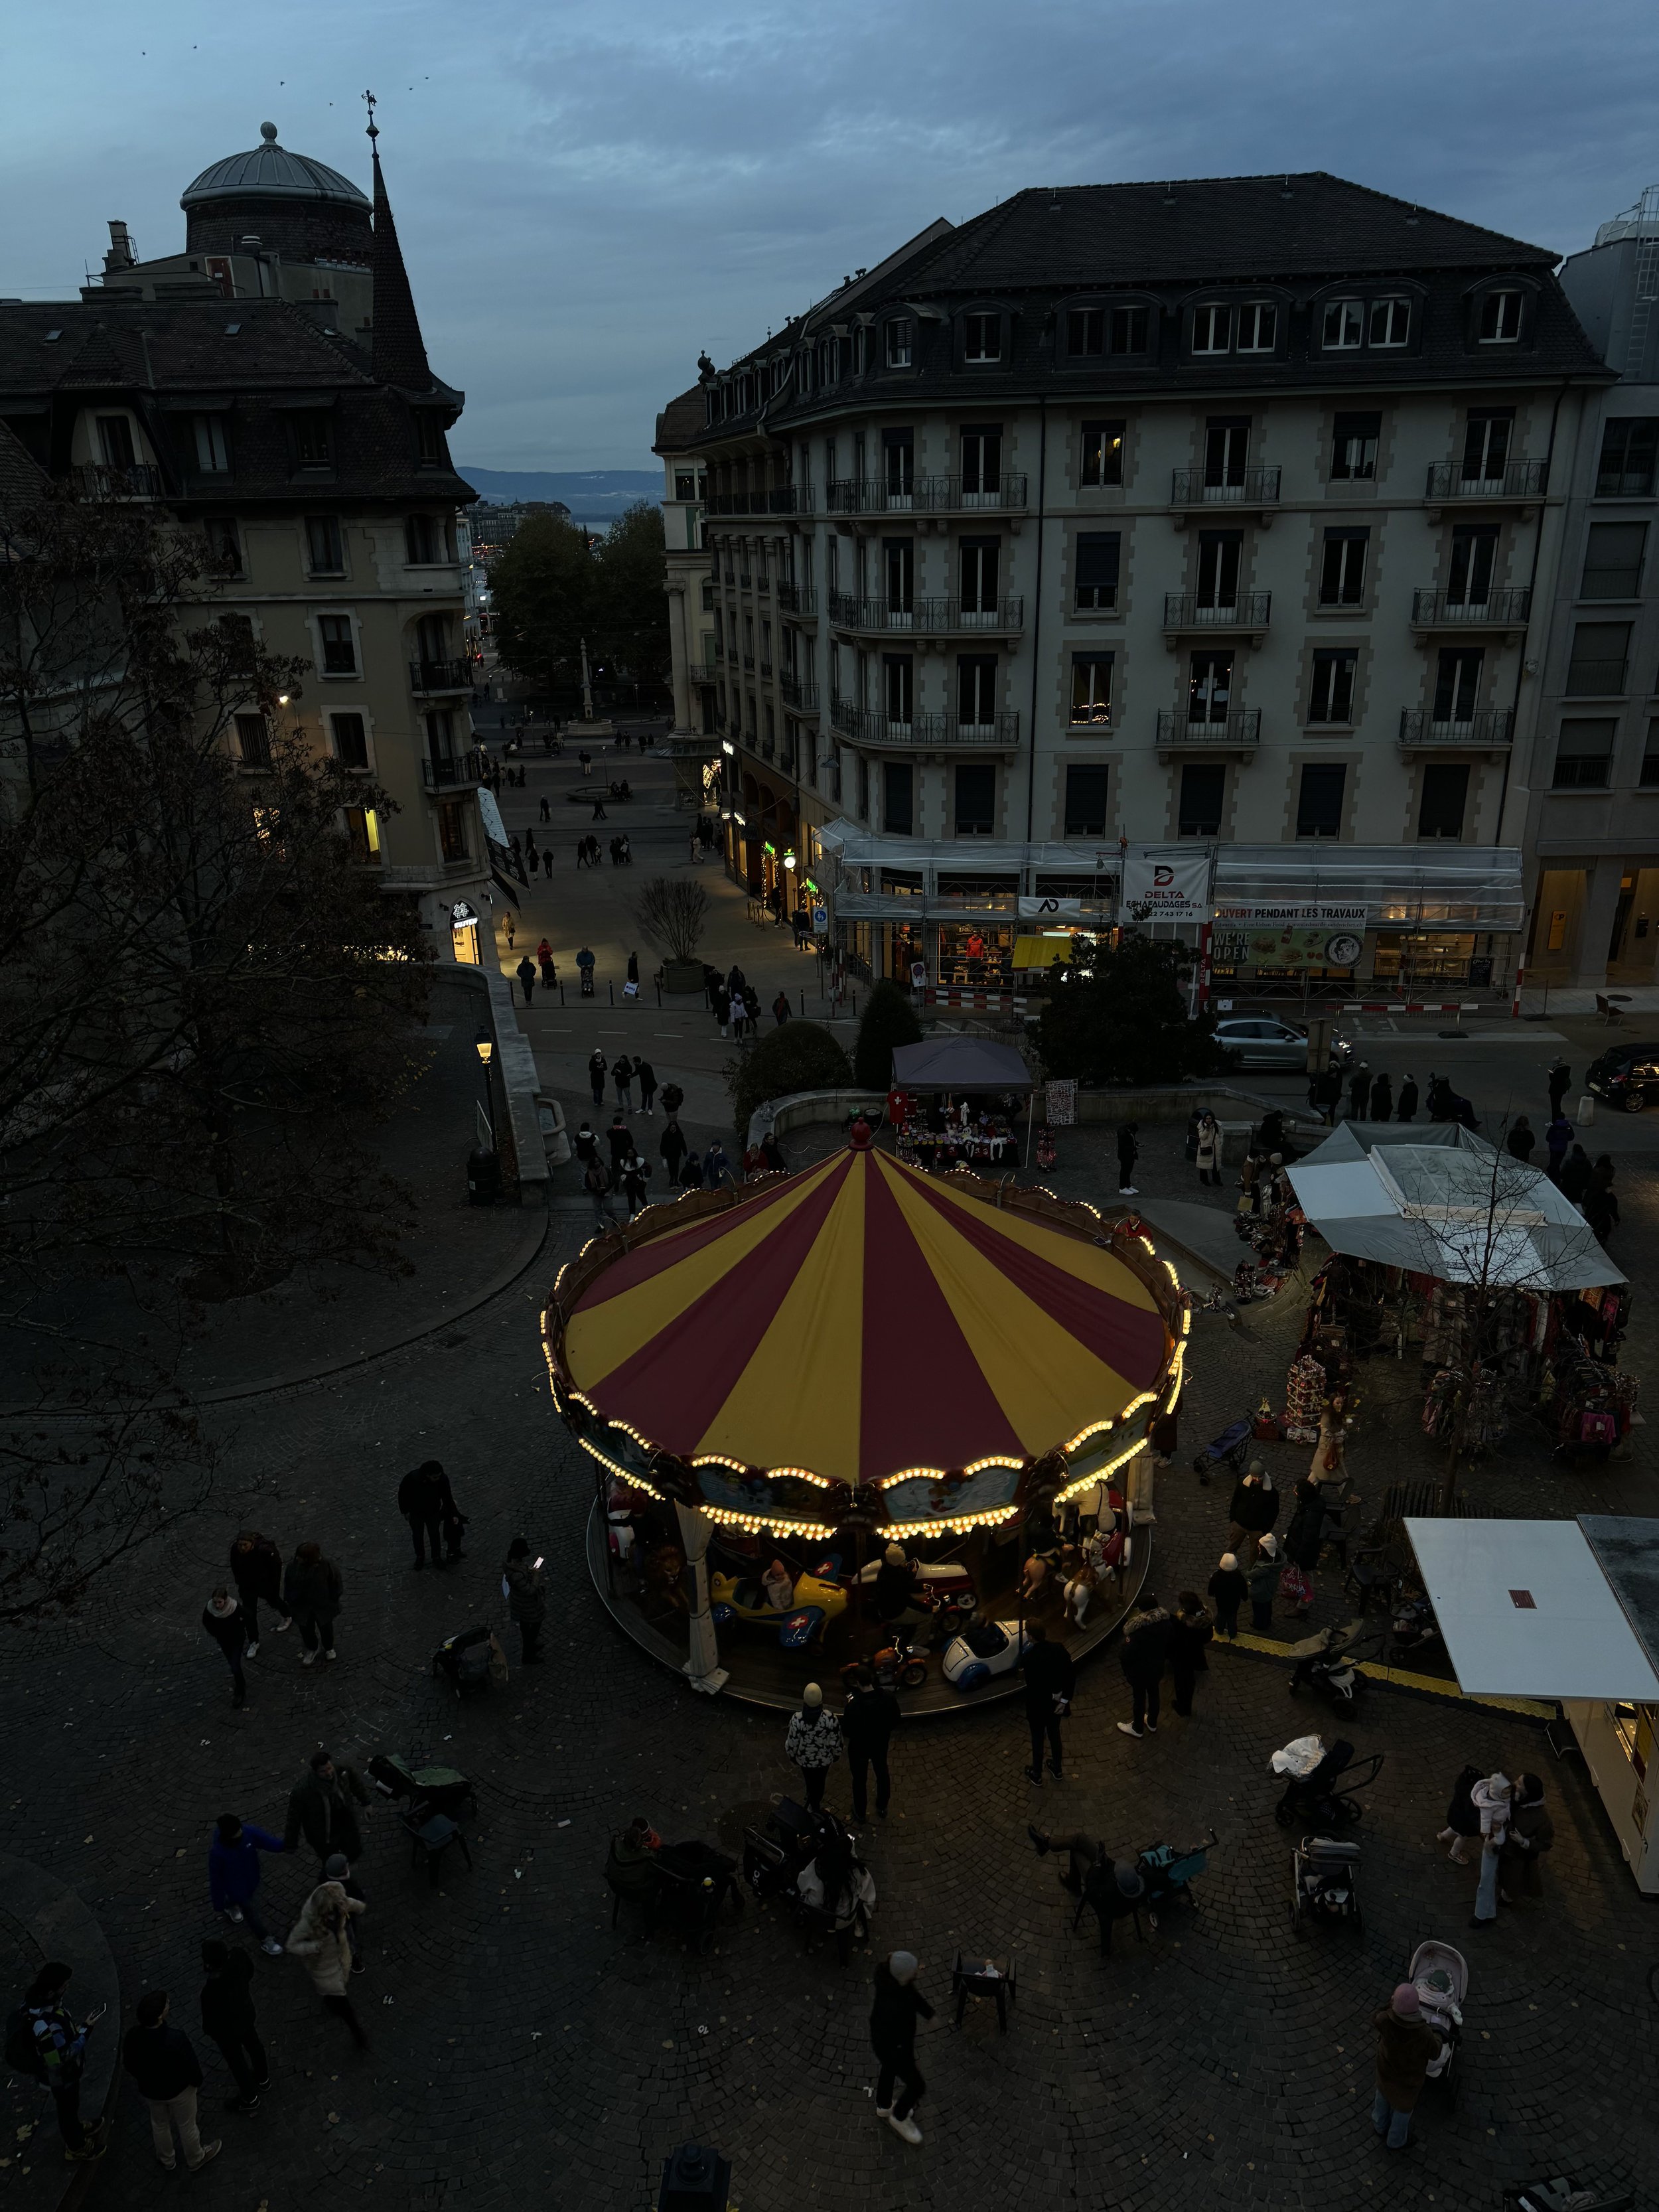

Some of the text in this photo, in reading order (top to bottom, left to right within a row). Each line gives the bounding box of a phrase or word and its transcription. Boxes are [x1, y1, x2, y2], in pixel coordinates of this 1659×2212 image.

[1255, 909, 1299, 918] PENDANT
[1302, 909, 1318, 918] LES
[1321, 908, 1366, 918] TRAVAUX
[1214, 932, 1250, 946] WE'RE
[1214, 946, 1249, 960] OPEN
